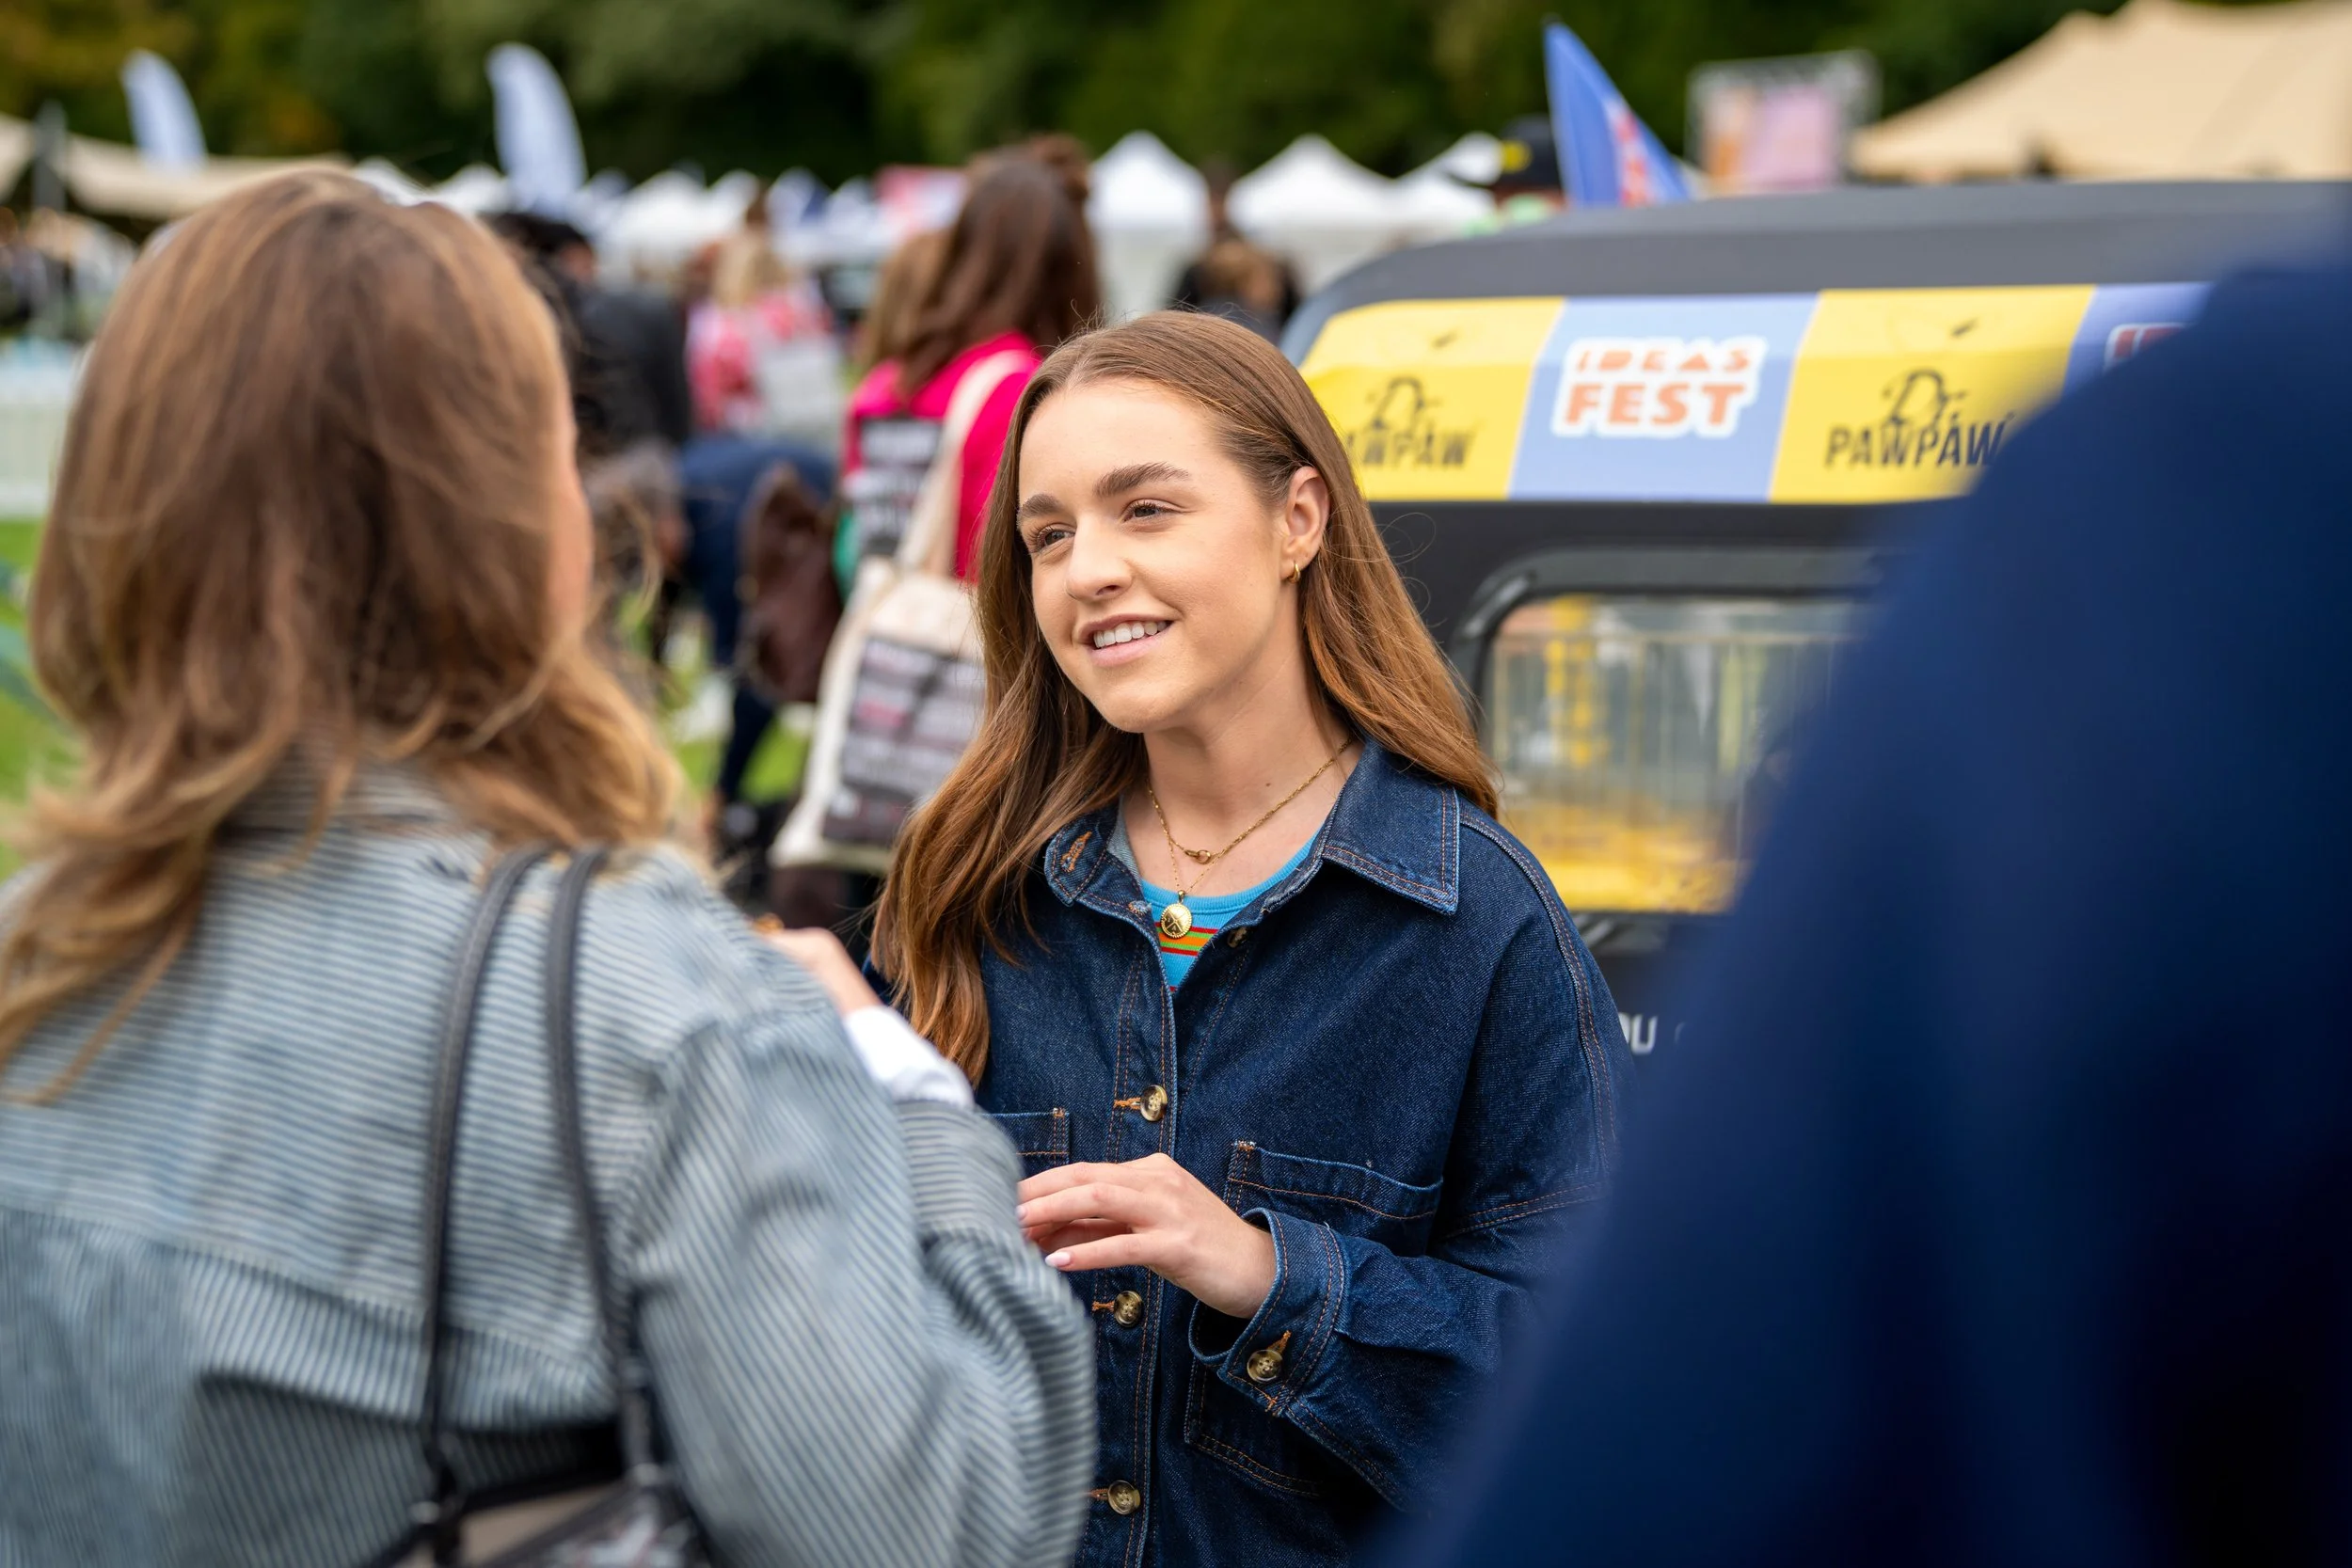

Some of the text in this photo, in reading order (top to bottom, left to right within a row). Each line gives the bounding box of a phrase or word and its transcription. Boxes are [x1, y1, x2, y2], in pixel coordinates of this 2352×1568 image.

[1576, 349, 1753, 372] IDEAS
[1565, 381, 1746, 426] FEST
[1824, 421, 2008, 468] PAWPAW
